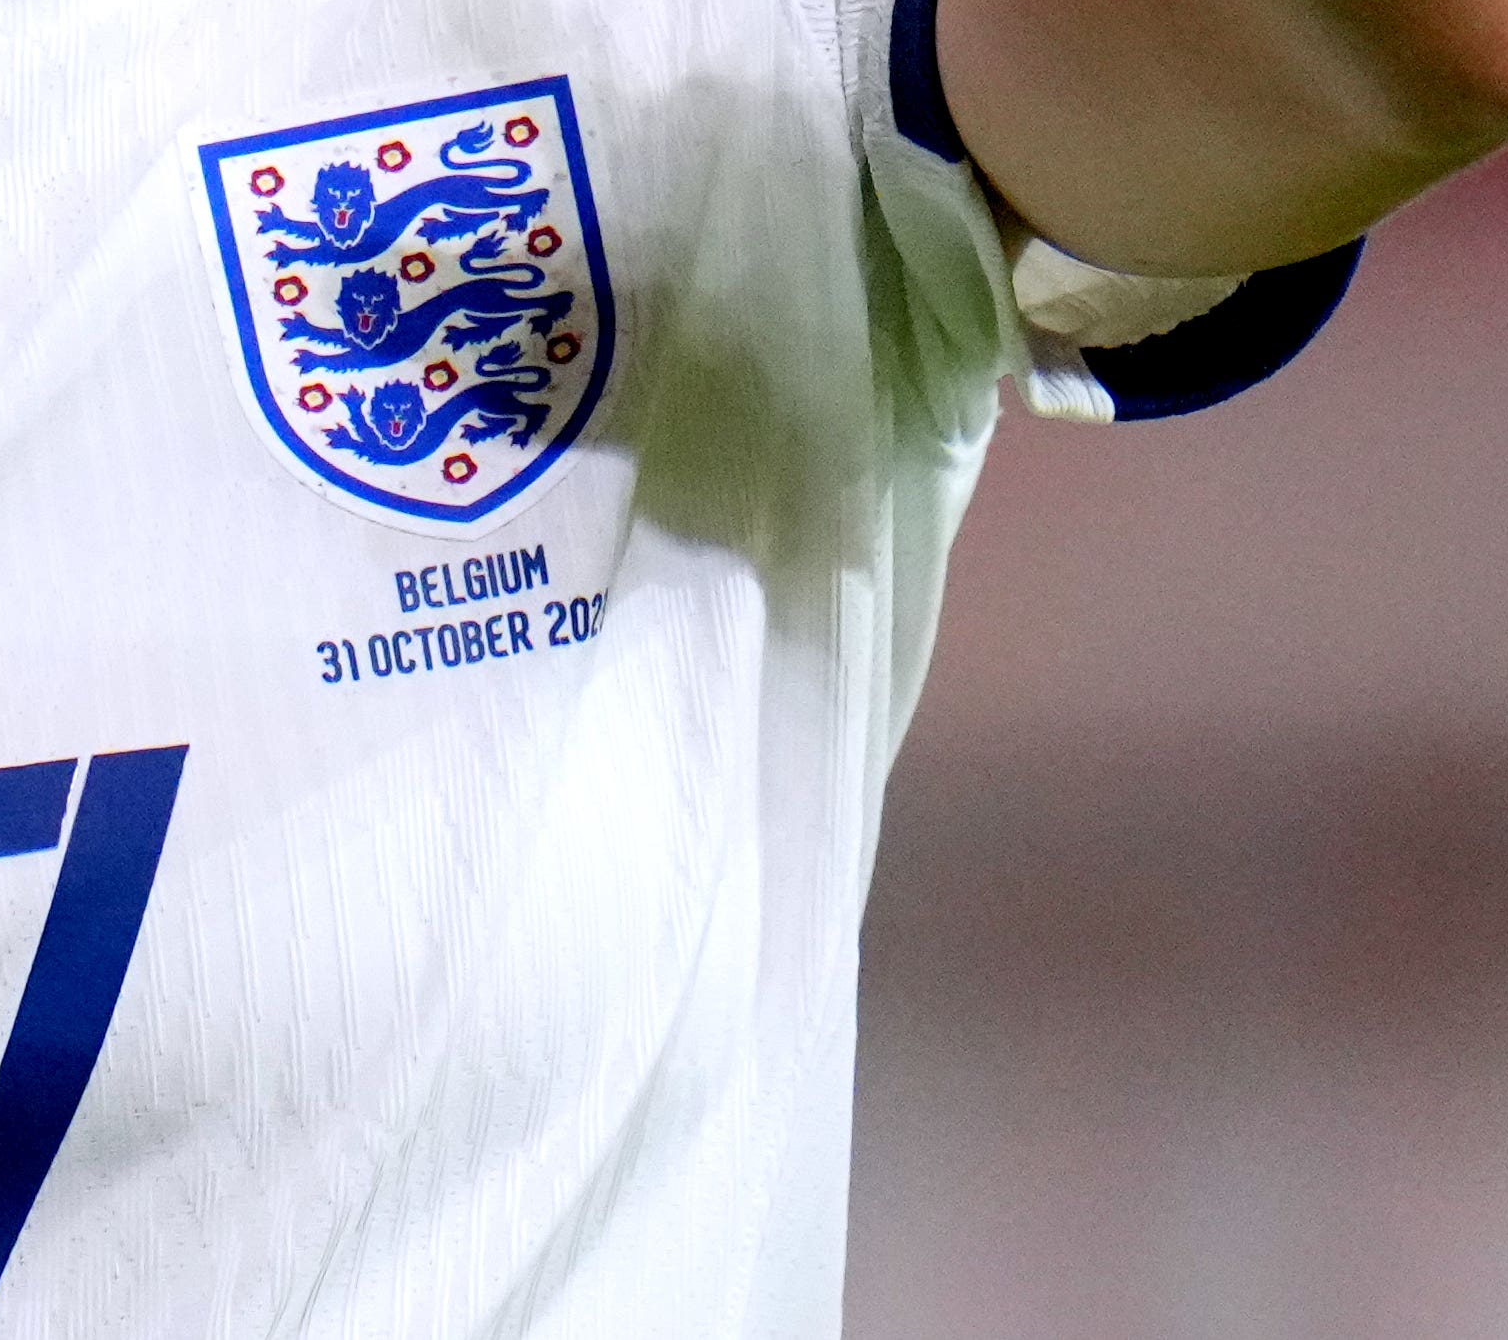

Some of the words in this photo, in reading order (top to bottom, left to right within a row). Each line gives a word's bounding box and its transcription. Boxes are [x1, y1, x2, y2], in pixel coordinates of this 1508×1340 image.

[395, 544, 549, 613] BELGIUM
[317, 640, 360, 683] 31
[368, 611, 533, 677] OCTOBER
[544, 588, 608, 647] 202
